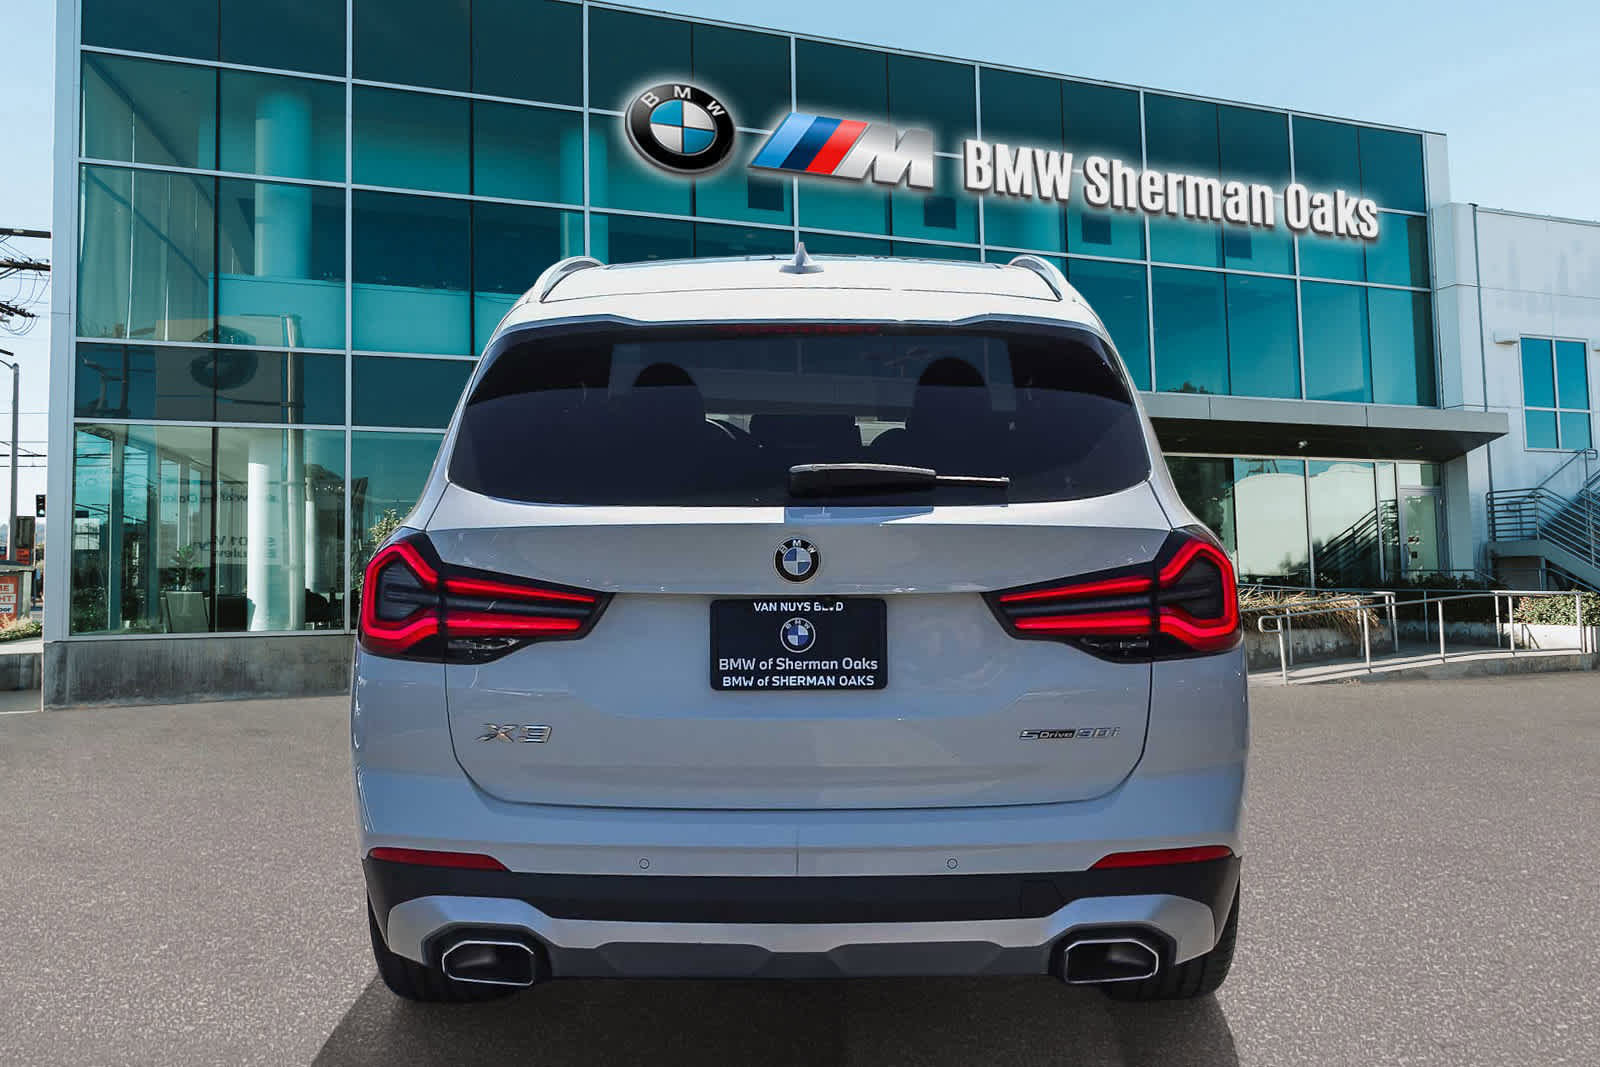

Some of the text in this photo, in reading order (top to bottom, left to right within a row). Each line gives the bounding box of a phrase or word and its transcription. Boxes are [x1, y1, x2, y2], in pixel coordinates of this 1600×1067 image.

[964, 139, 1379, 241] BMW Sherman Oaks
[753, 602, 844, 612] VAN NUYS BD
[719, 657, 878, 671] BMW of Sherman Oaks
[722, 675, 875, 687] BMW of SHERMAN OAKS
[475, 723, 552, 743] X3
